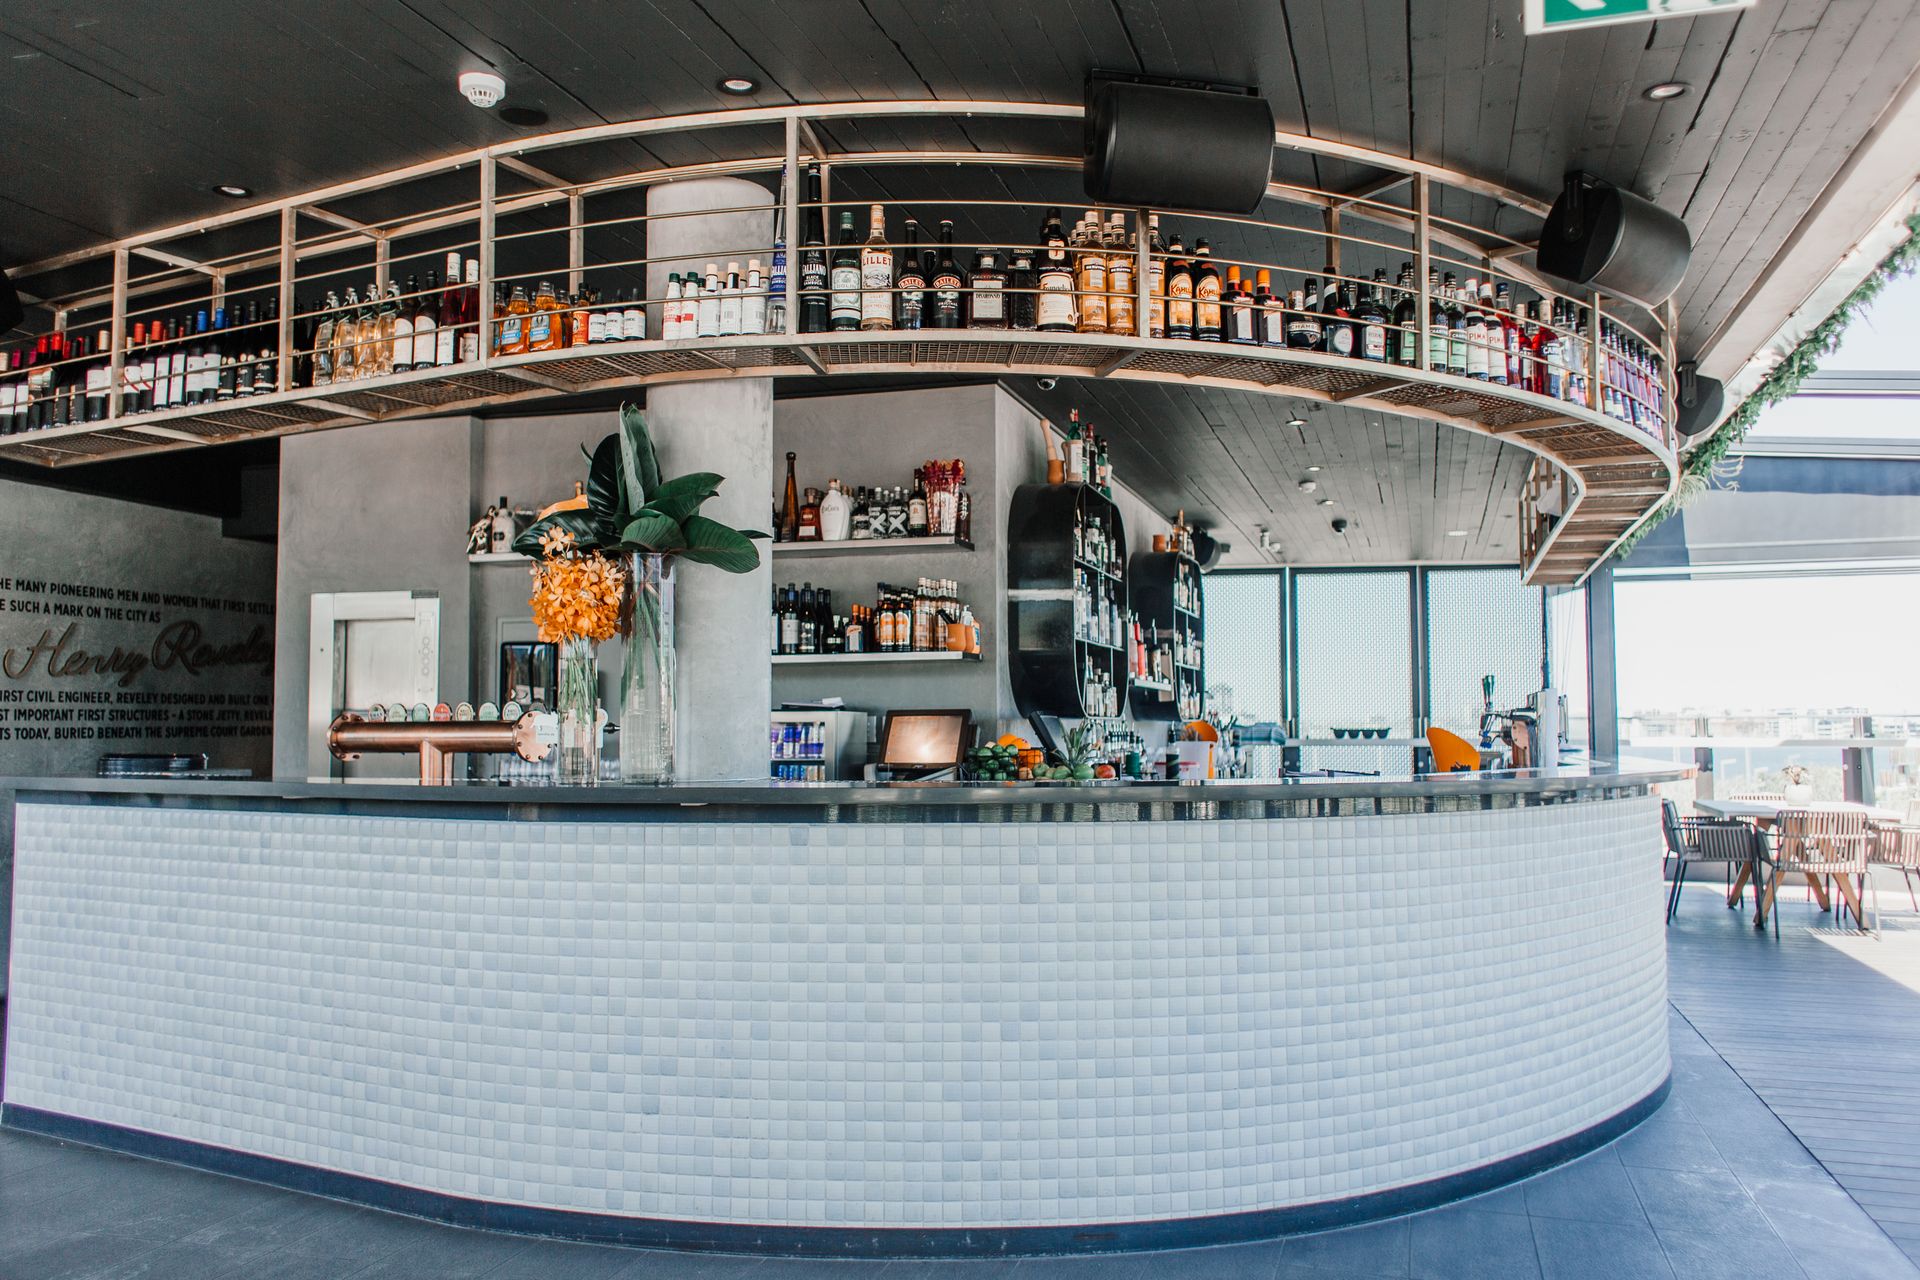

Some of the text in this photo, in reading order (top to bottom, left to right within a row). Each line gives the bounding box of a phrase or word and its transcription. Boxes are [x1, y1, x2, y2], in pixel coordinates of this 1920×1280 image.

[862, 256, 892, 267] LILLET
[900, 279, 926, 289] BAILEYS
[935, 279, 961, 288] BAILEYS
[16, 579, 47, 593] MANY
[50, 582, 114, 600] PIONEERING
[117, 589, 139, 603] MEN
[142, 591, 160, 604] AND
[163, 593, 198, 608] WOMEN
[201, 597, 220, 609] THAT
[223, 599, 245, 613] FIRST
[10, 600, 40, 614] SUCH
[43, 602, 51, 615] A
[54, 603, 84, 617] MARK
[87, 606, 101, 619] ON
[104, 607, 123, 621] THE
[126, 609, 147, 623] CITY
[149, 611, 161, 624] AS
[3, 622, 150, 688] Henry
[27, 690, 55, 703] CIVIL
[58, 690, 113, 705] ENGINEER,
[116, 692, 159, 705] REVELEY
[160, 693, 206, 705] DESIGNED
[208, 694, 225, 705] AND
[228, 694, 250, 706] BUILT
[252, 695, 269, 706] ONE
[14, 709, 75, 721] IMPORTANT
[78, 709, 106, 721] FIRST
[108, 709, 169, 722] STRUCTURES
[178, 709, 184, 720] A
[186, 709, 214, 721] STONE
[14, 727, 51, 741] TODAY,
[54, 727, 95, 740] BURIED
[97, 727, 142, 740] BENEATH
[145, 727, 163, 739] THE
[165, 726, 209, 739] SUPREME
[210, 726, 238, 738] COURT
